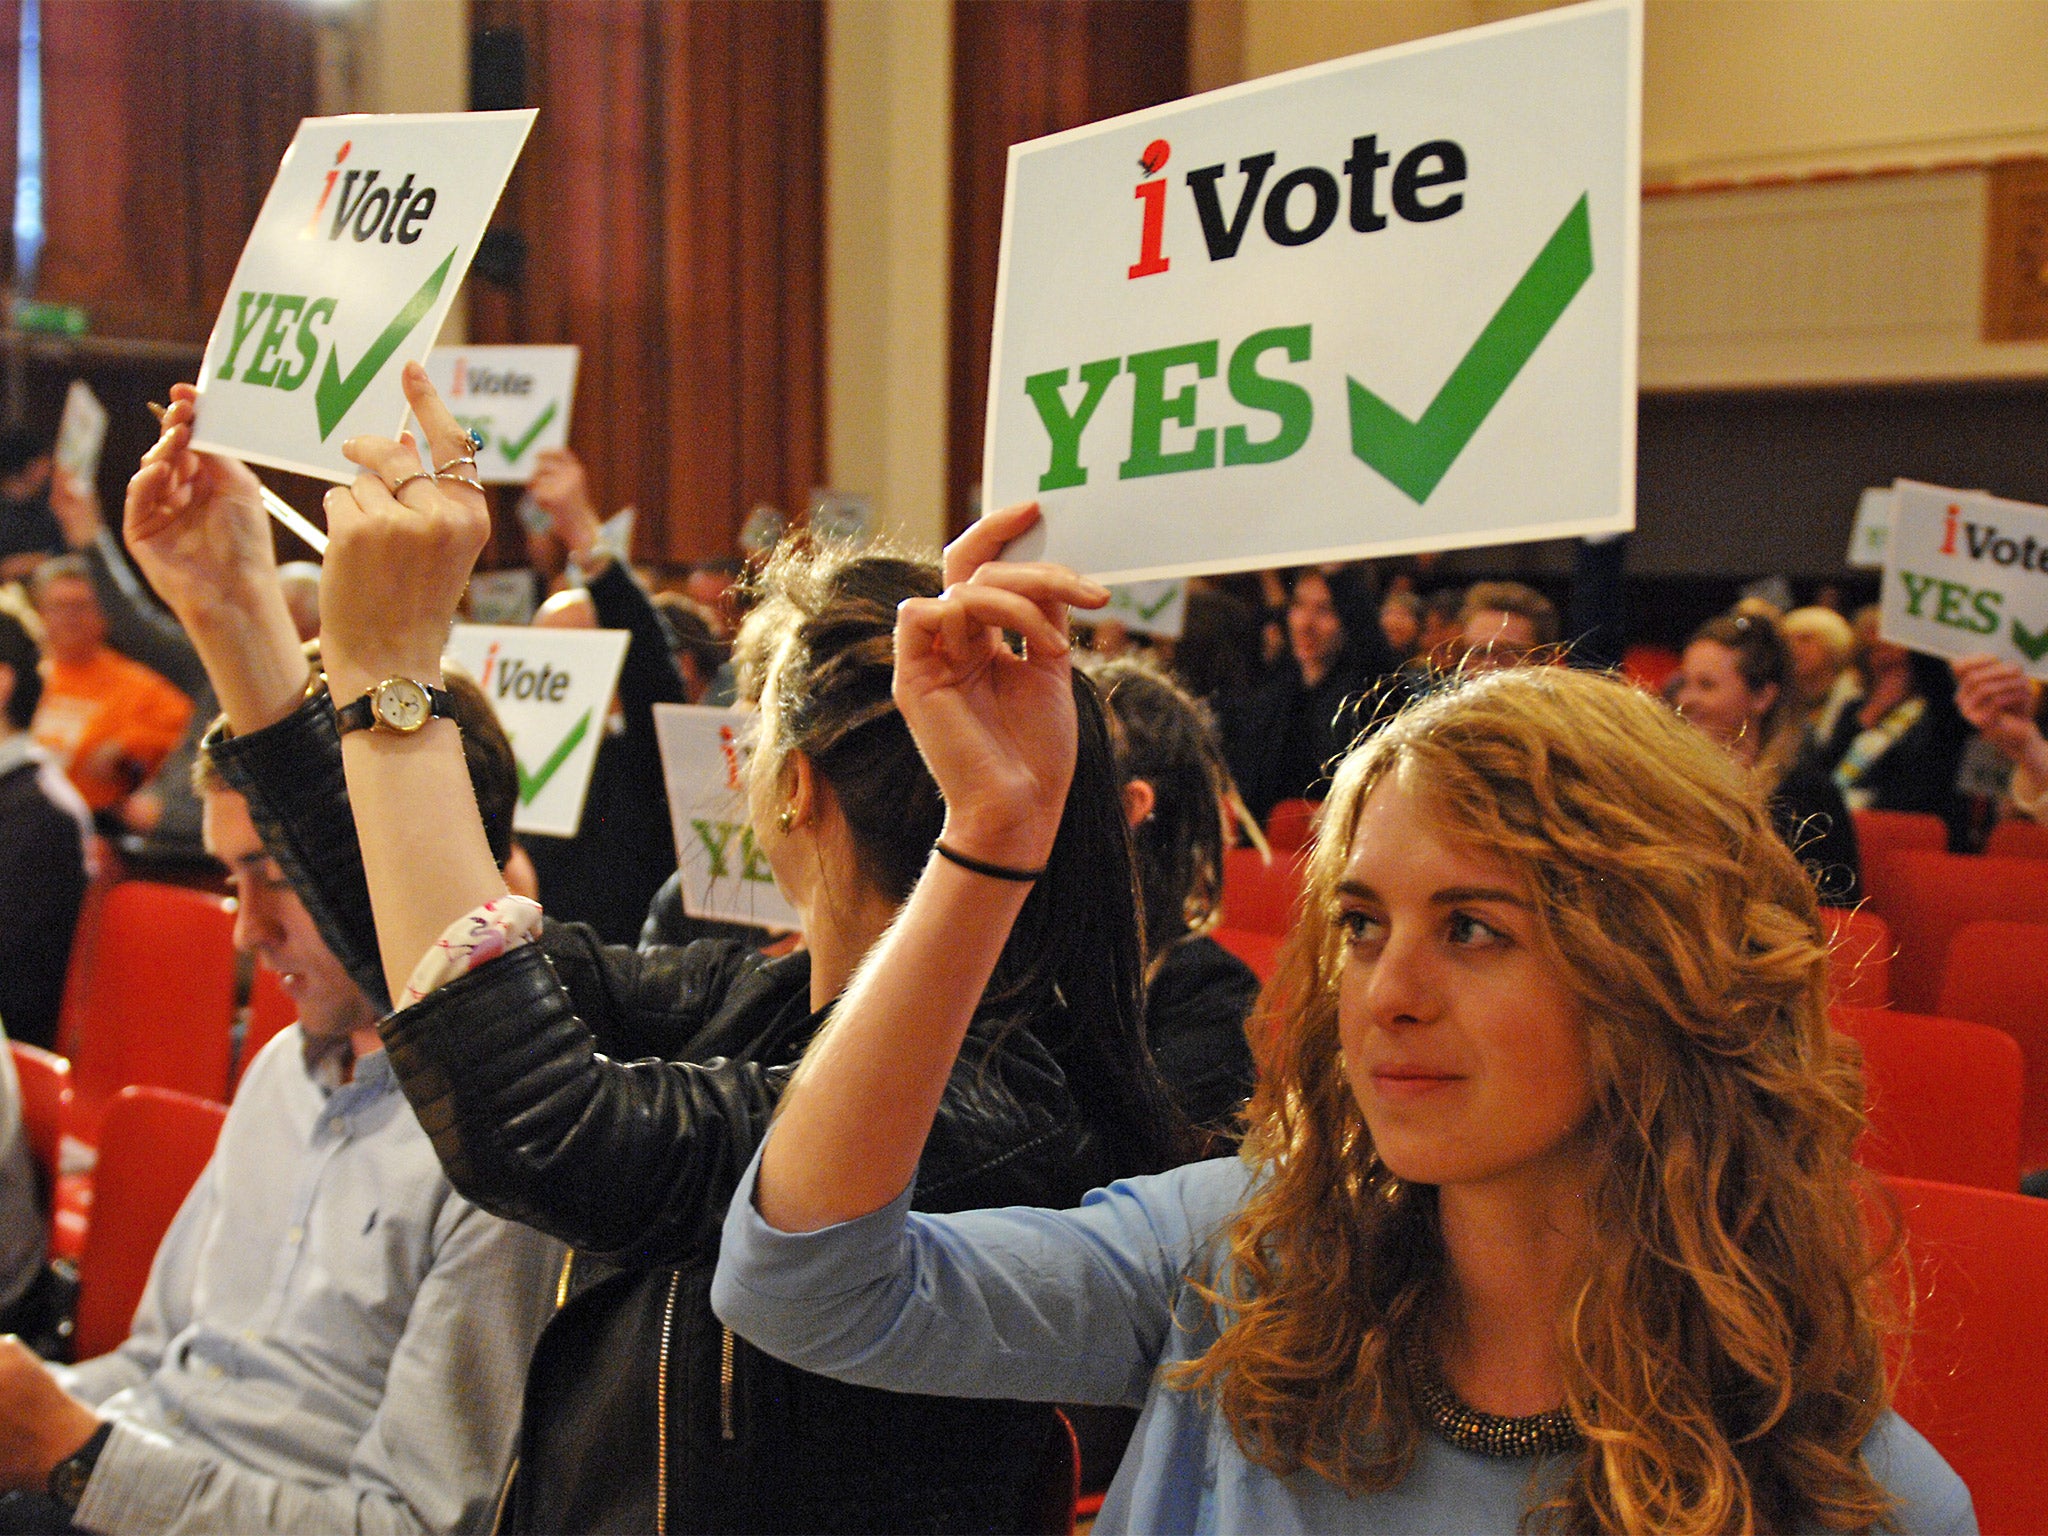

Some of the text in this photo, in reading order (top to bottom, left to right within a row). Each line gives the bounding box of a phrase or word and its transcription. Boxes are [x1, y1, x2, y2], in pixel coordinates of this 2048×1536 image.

[301, 140, 436, 244] i Vote
[1128, 134, 1467, 279] i Vote
[217, 291, 338, 392] YES
[467, 367, 534, 395] Vote
[1024, 323, 1314, 493] YES
[1939, 503, 1961, 556] i
[1900, 569, 2004, 635] YES
[497, 659, 570, 703] Vote
[691, 819, 775, 883] YE
